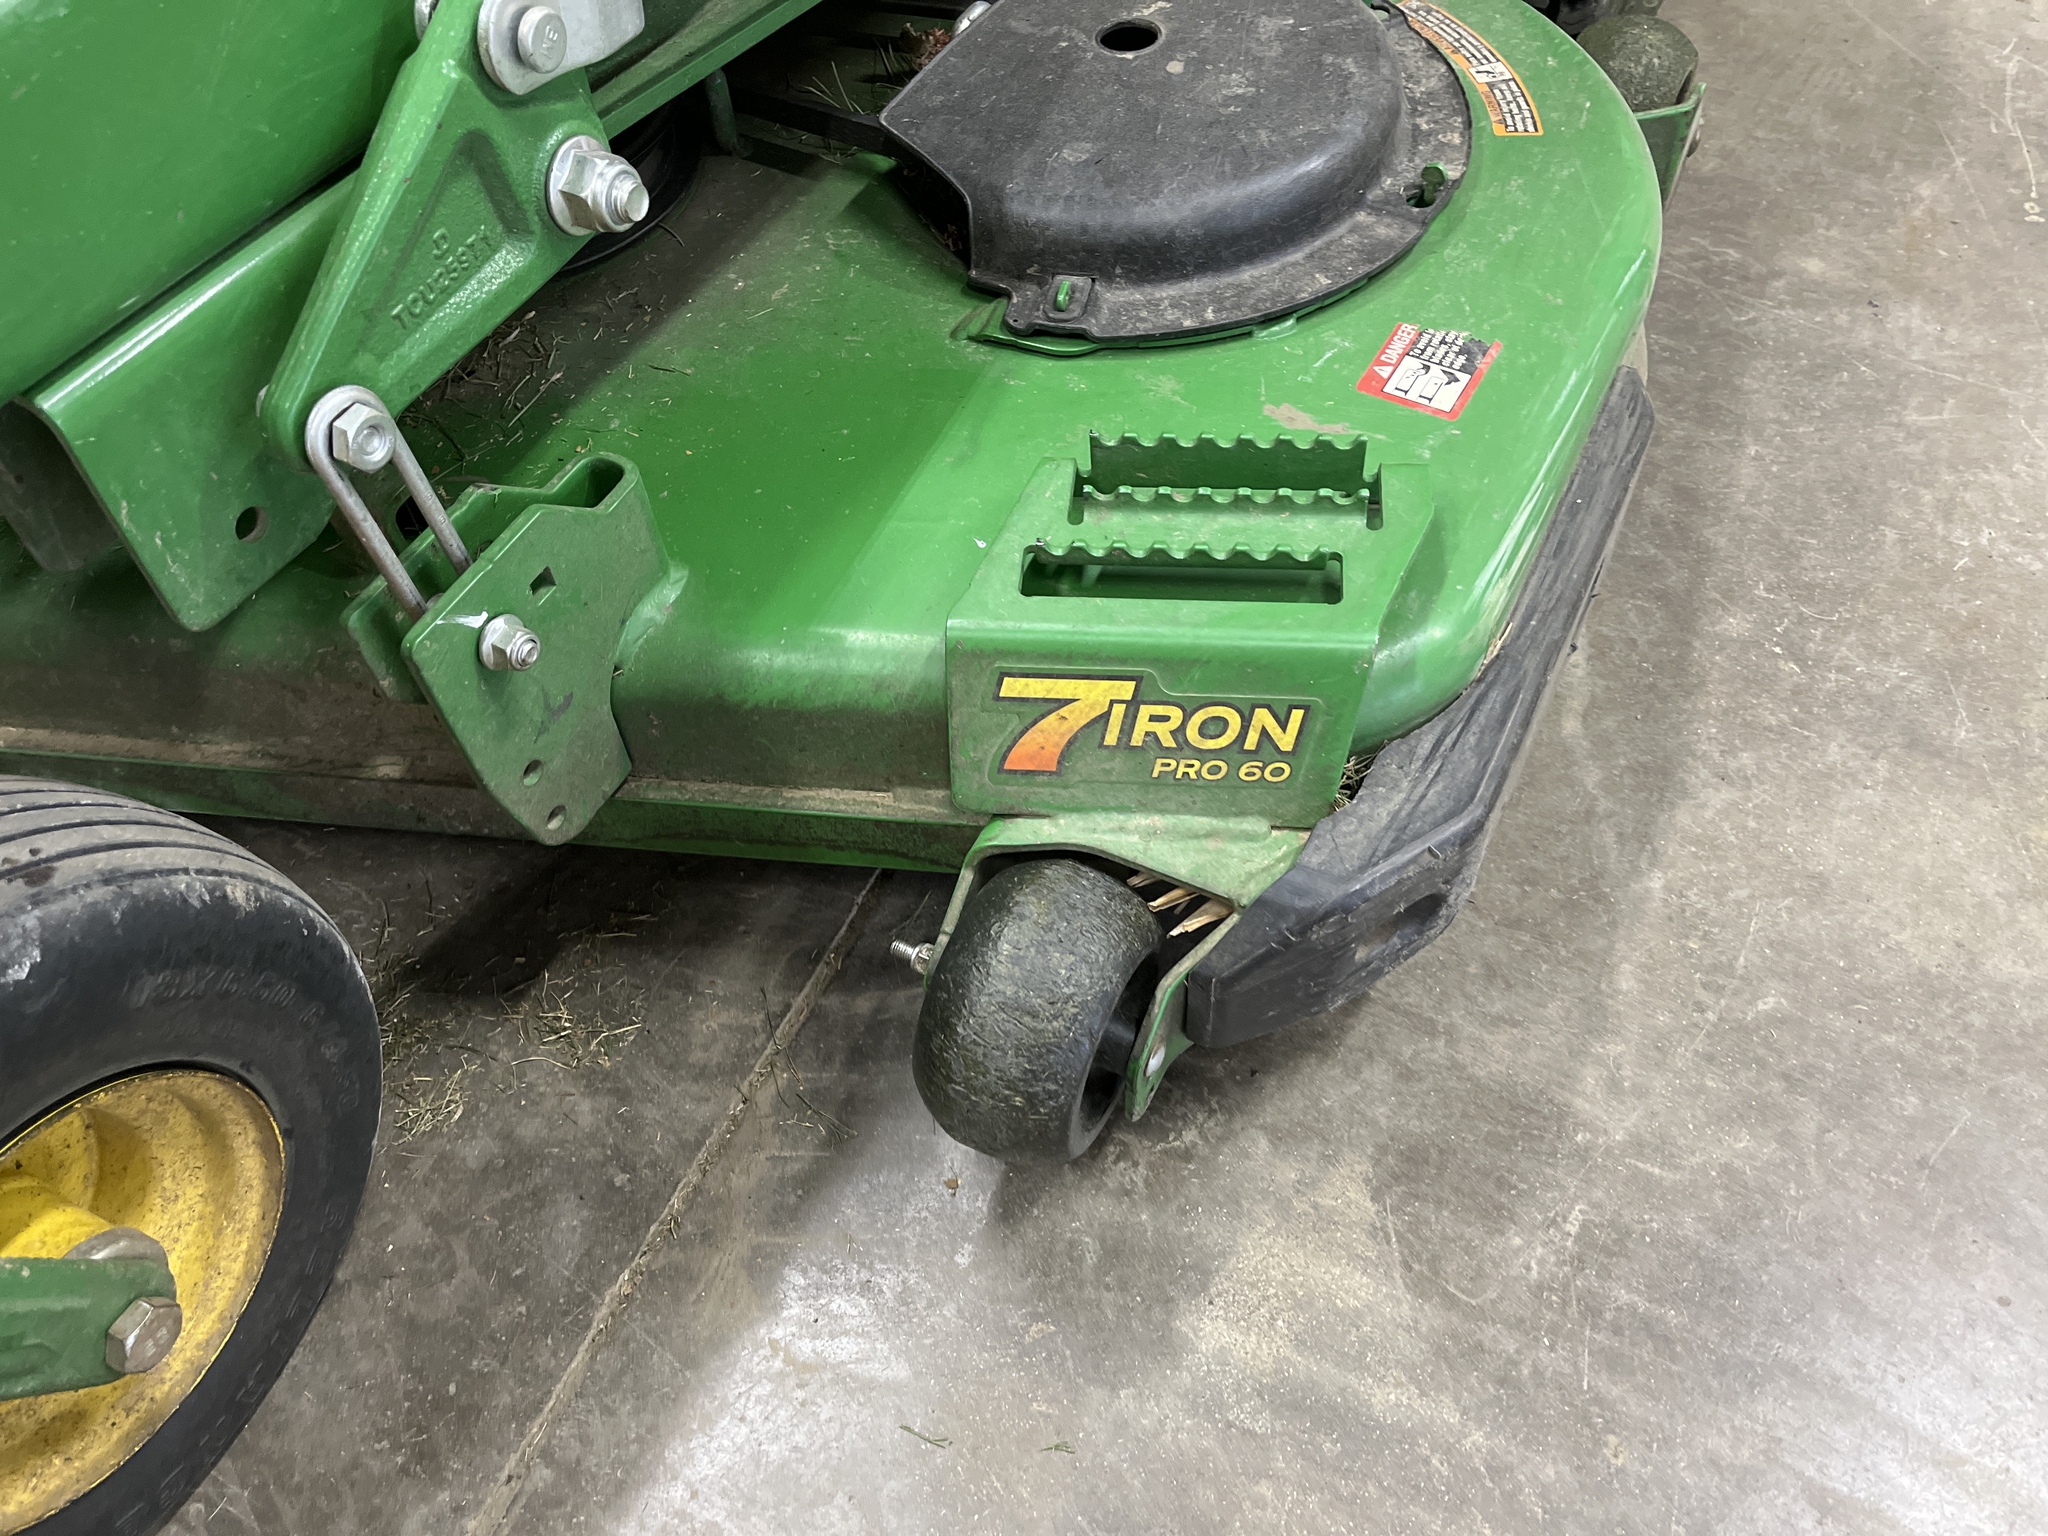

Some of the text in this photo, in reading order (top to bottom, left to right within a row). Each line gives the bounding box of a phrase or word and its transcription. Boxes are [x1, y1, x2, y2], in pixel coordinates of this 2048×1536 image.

[1380, 322, 1418, 364] DANGER
[997, 674, 1306, 772] 7 IRON
[1151, 756, 1292, 783] PRO 60
